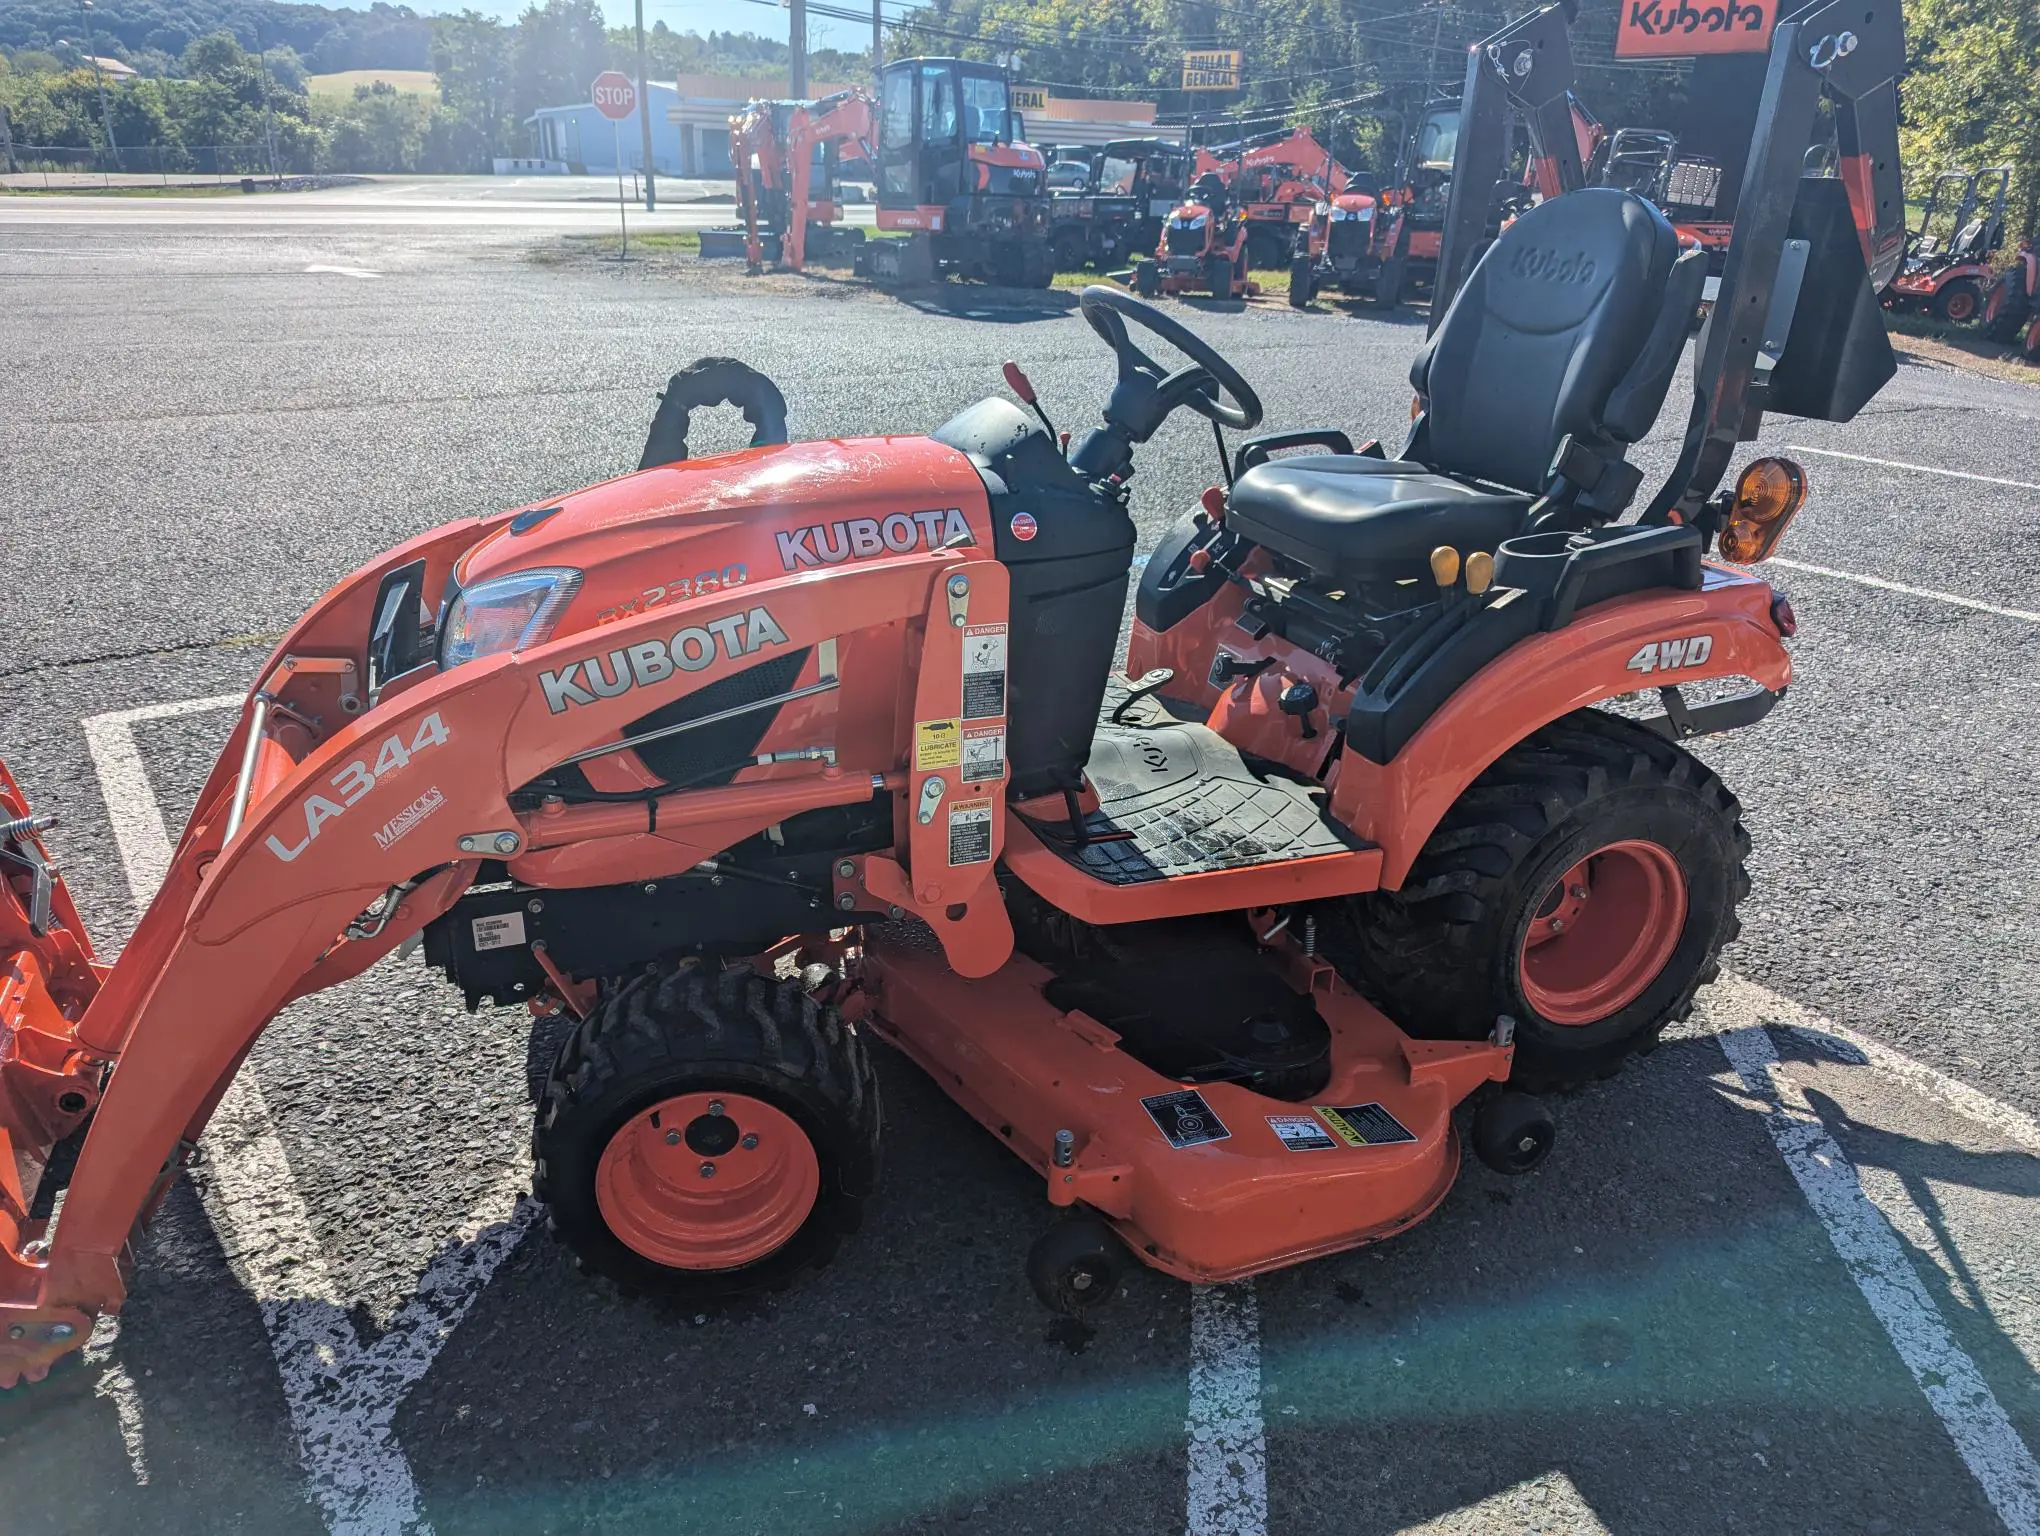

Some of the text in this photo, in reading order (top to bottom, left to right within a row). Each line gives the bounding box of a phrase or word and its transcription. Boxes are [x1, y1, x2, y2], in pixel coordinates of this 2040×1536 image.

[1630, 0, 1764, 35] Kubota
[1186, 71, 1233, 87] GENERAL
[595, 86, 633, 105] STOP
[1509, 246, 1597, 287] Kubota
[774, 507, 976, 571] KUBOTA
[974, 625, 1007, 636] DANGER
[537, 605, 791, 716] KUBOTA
[1626, 634, 1713, 674] 4WD
[920, 741, 957, 752] LUBRICATE
[973, 728, 1003, 738] DANGER
[264, 711, 450, 863] LA344
[372, 785, 442, 849] MESSICK'S
[959, 800, 990, 810] WARNING
[1276, 1115, 1314, 1123] DANGER
[1320, 1107, 1360, 1137] CAUTION
